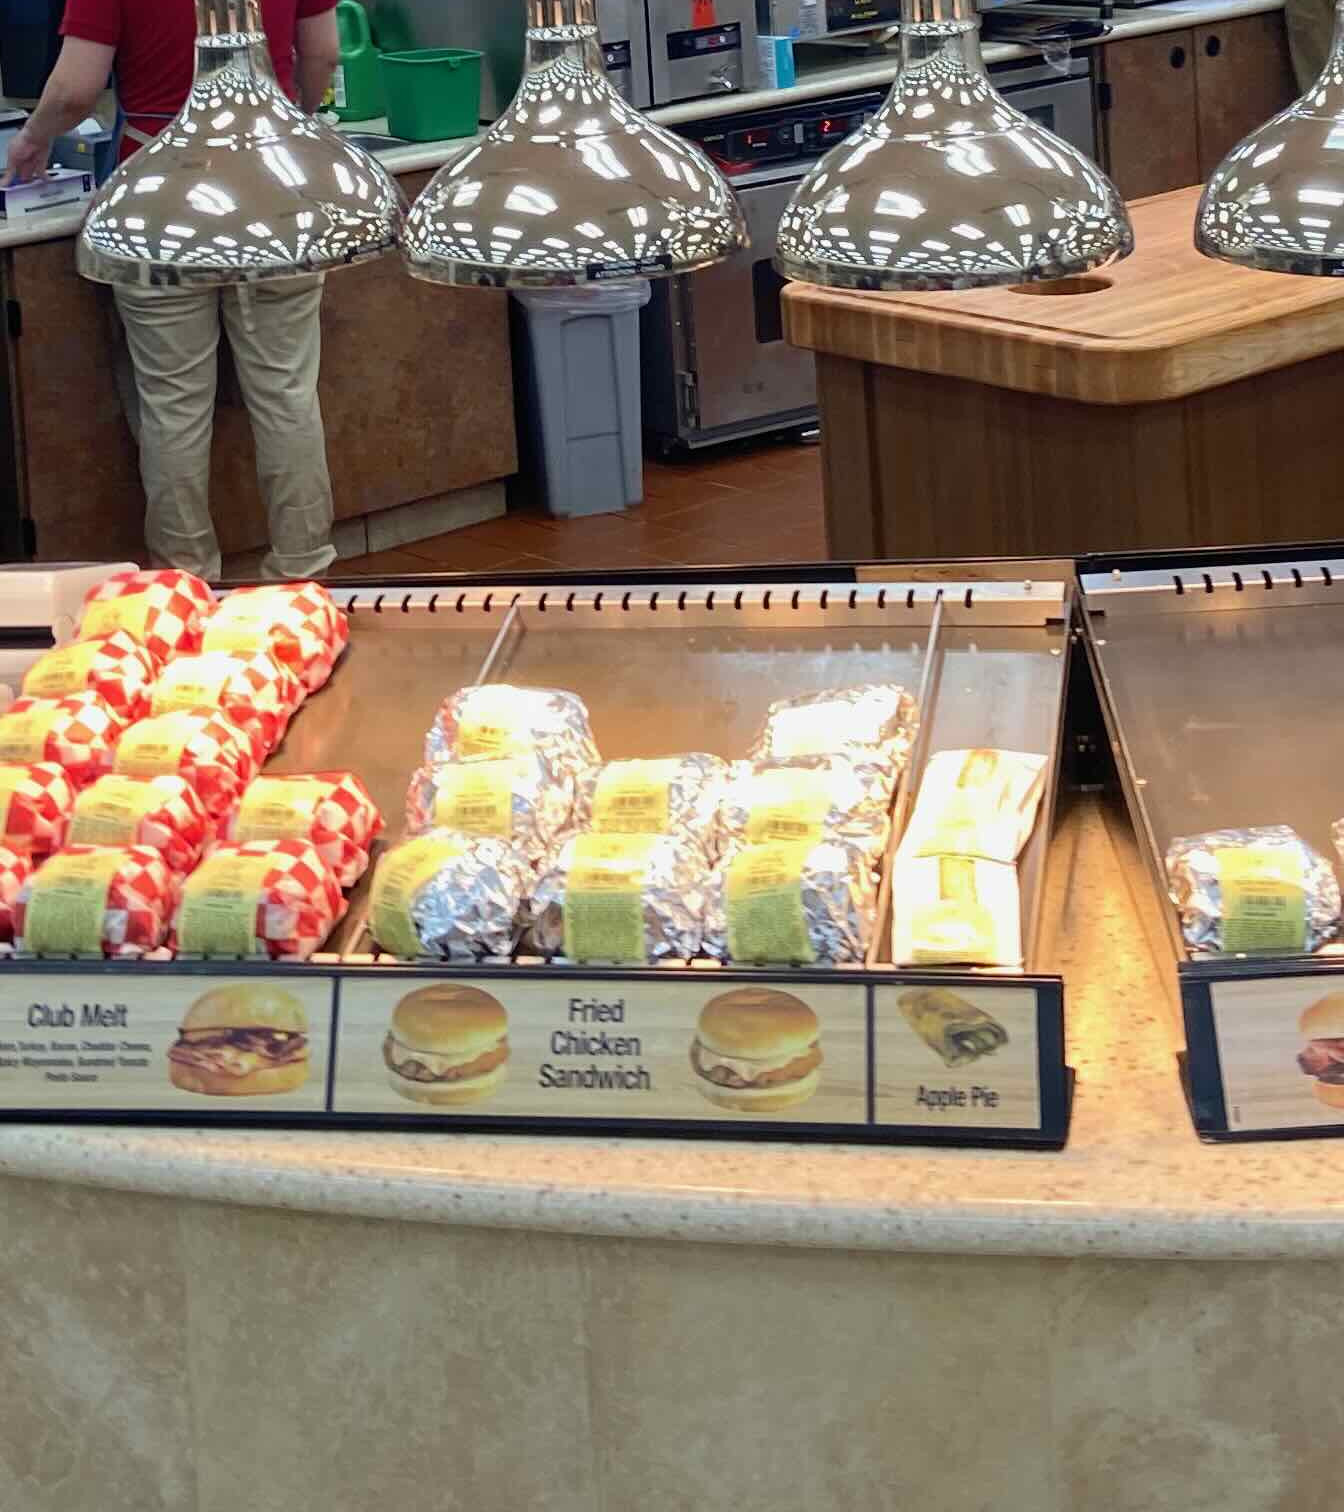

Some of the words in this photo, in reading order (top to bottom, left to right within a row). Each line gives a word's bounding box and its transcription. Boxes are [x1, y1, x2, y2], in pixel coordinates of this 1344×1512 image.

[27, 1003, 75, 1029] Club
[80, 1002, 128, 1028] Melt
[567, 998, 625, 1025] Fried
[549, 1030, 642, 1058] Chicken
[538, 1064, 651, 1092] Sandwich
[915, 1085, 967, 1113] Apple
[970, 1085, 999, 1109] Pie
